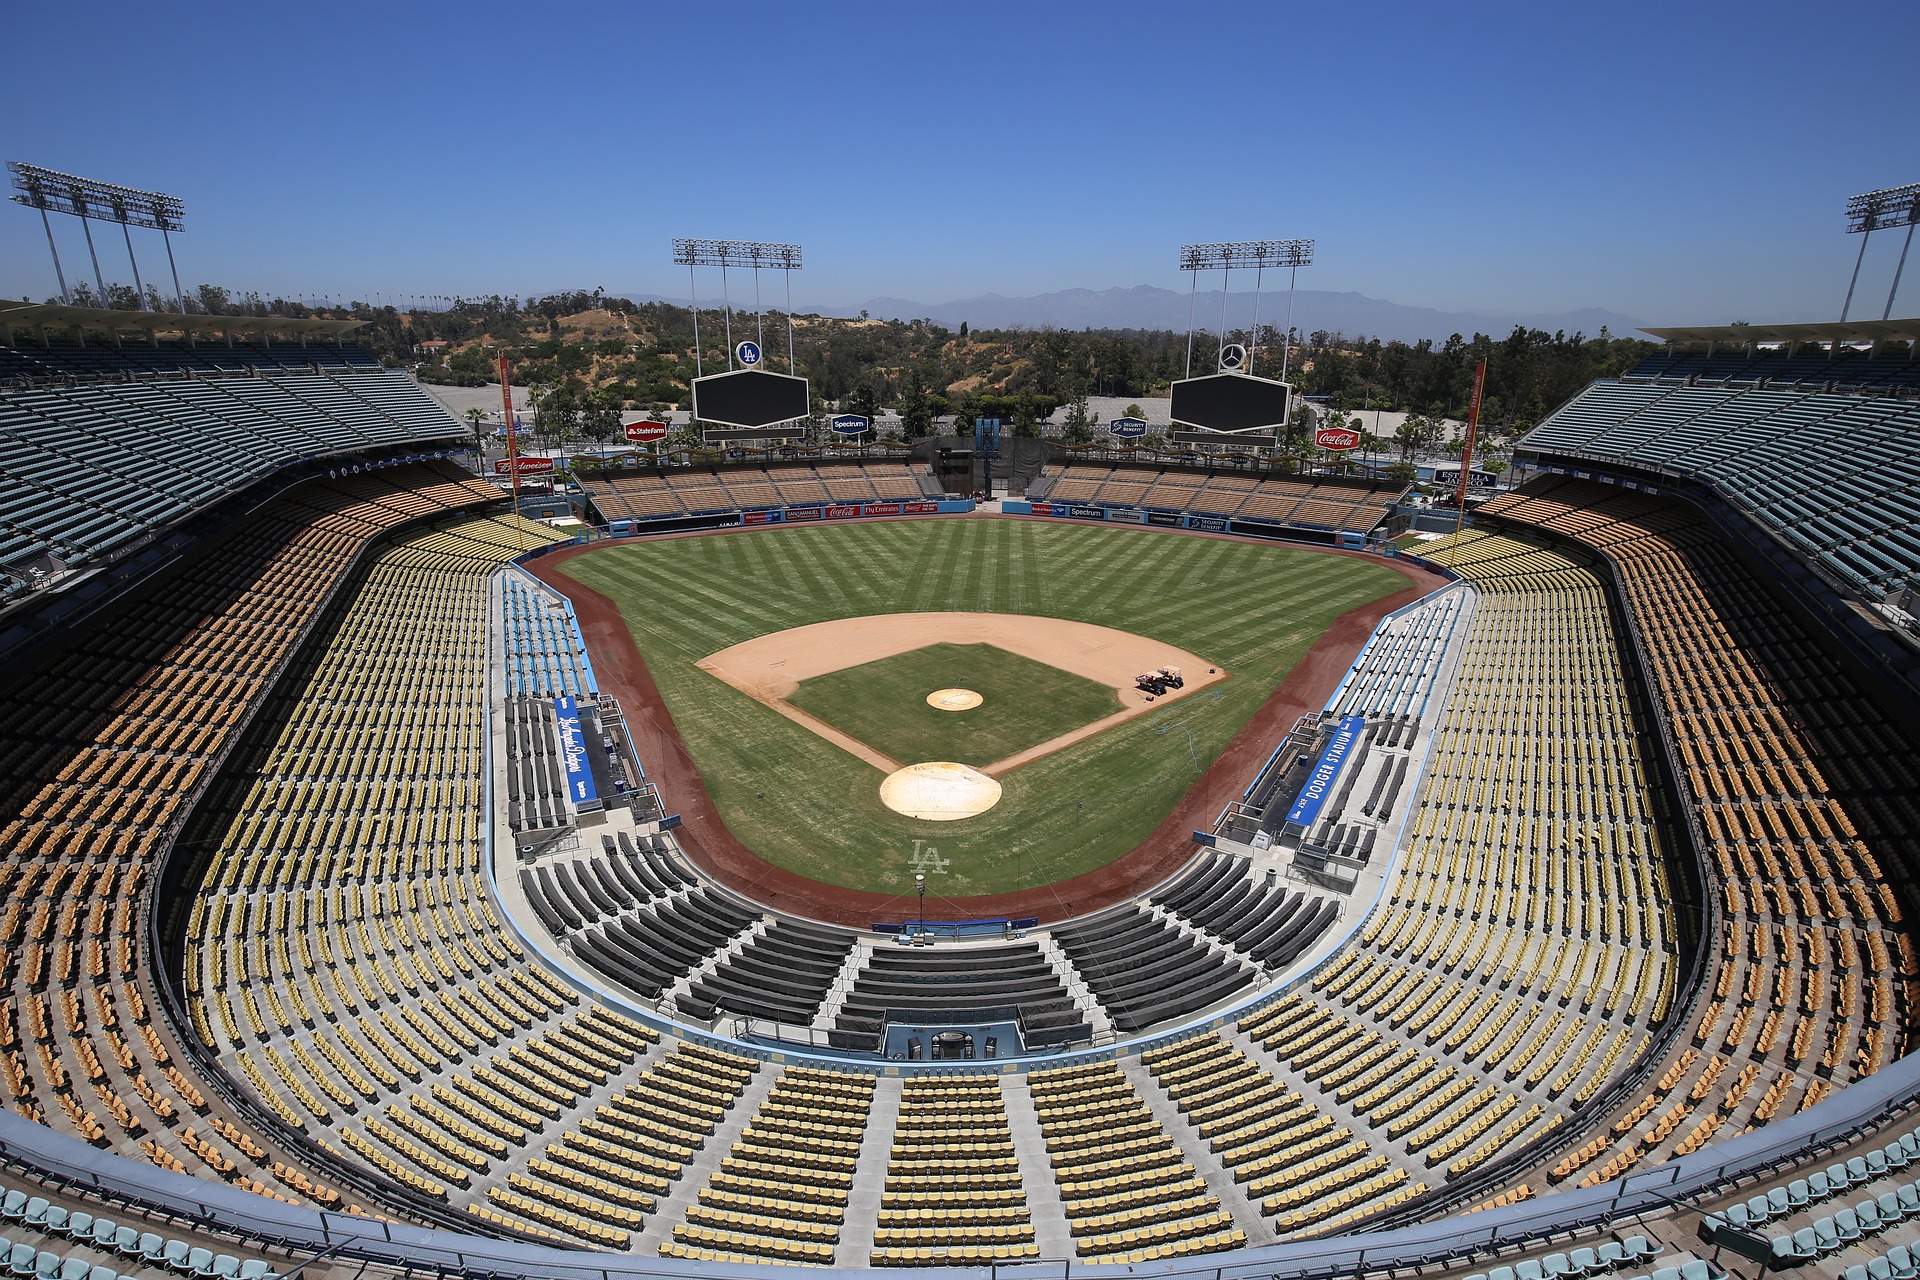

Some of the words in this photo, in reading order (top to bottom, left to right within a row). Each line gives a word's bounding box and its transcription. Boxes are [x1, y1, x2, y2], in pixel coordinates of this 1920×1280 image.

[743, 345, 755, 361] LA
[834, 420, 864, 428] Spectrum
[1319, 433, 1355, 446] Coca-Cola
[497, 461, 552, 472] Bdweiser
[1442, 471, 1489, 482] ESTELLA
[1445, 478, 1483, 487] JASCO
[1071, 508, 1101, 516] Spectrum
[564, 746, 586, 773] Dodgers
[1305, 764, 1335, 800] DODGER
[1325, 731, 1353, 763] STADIUM
[907, 839, 950, 874] LA
